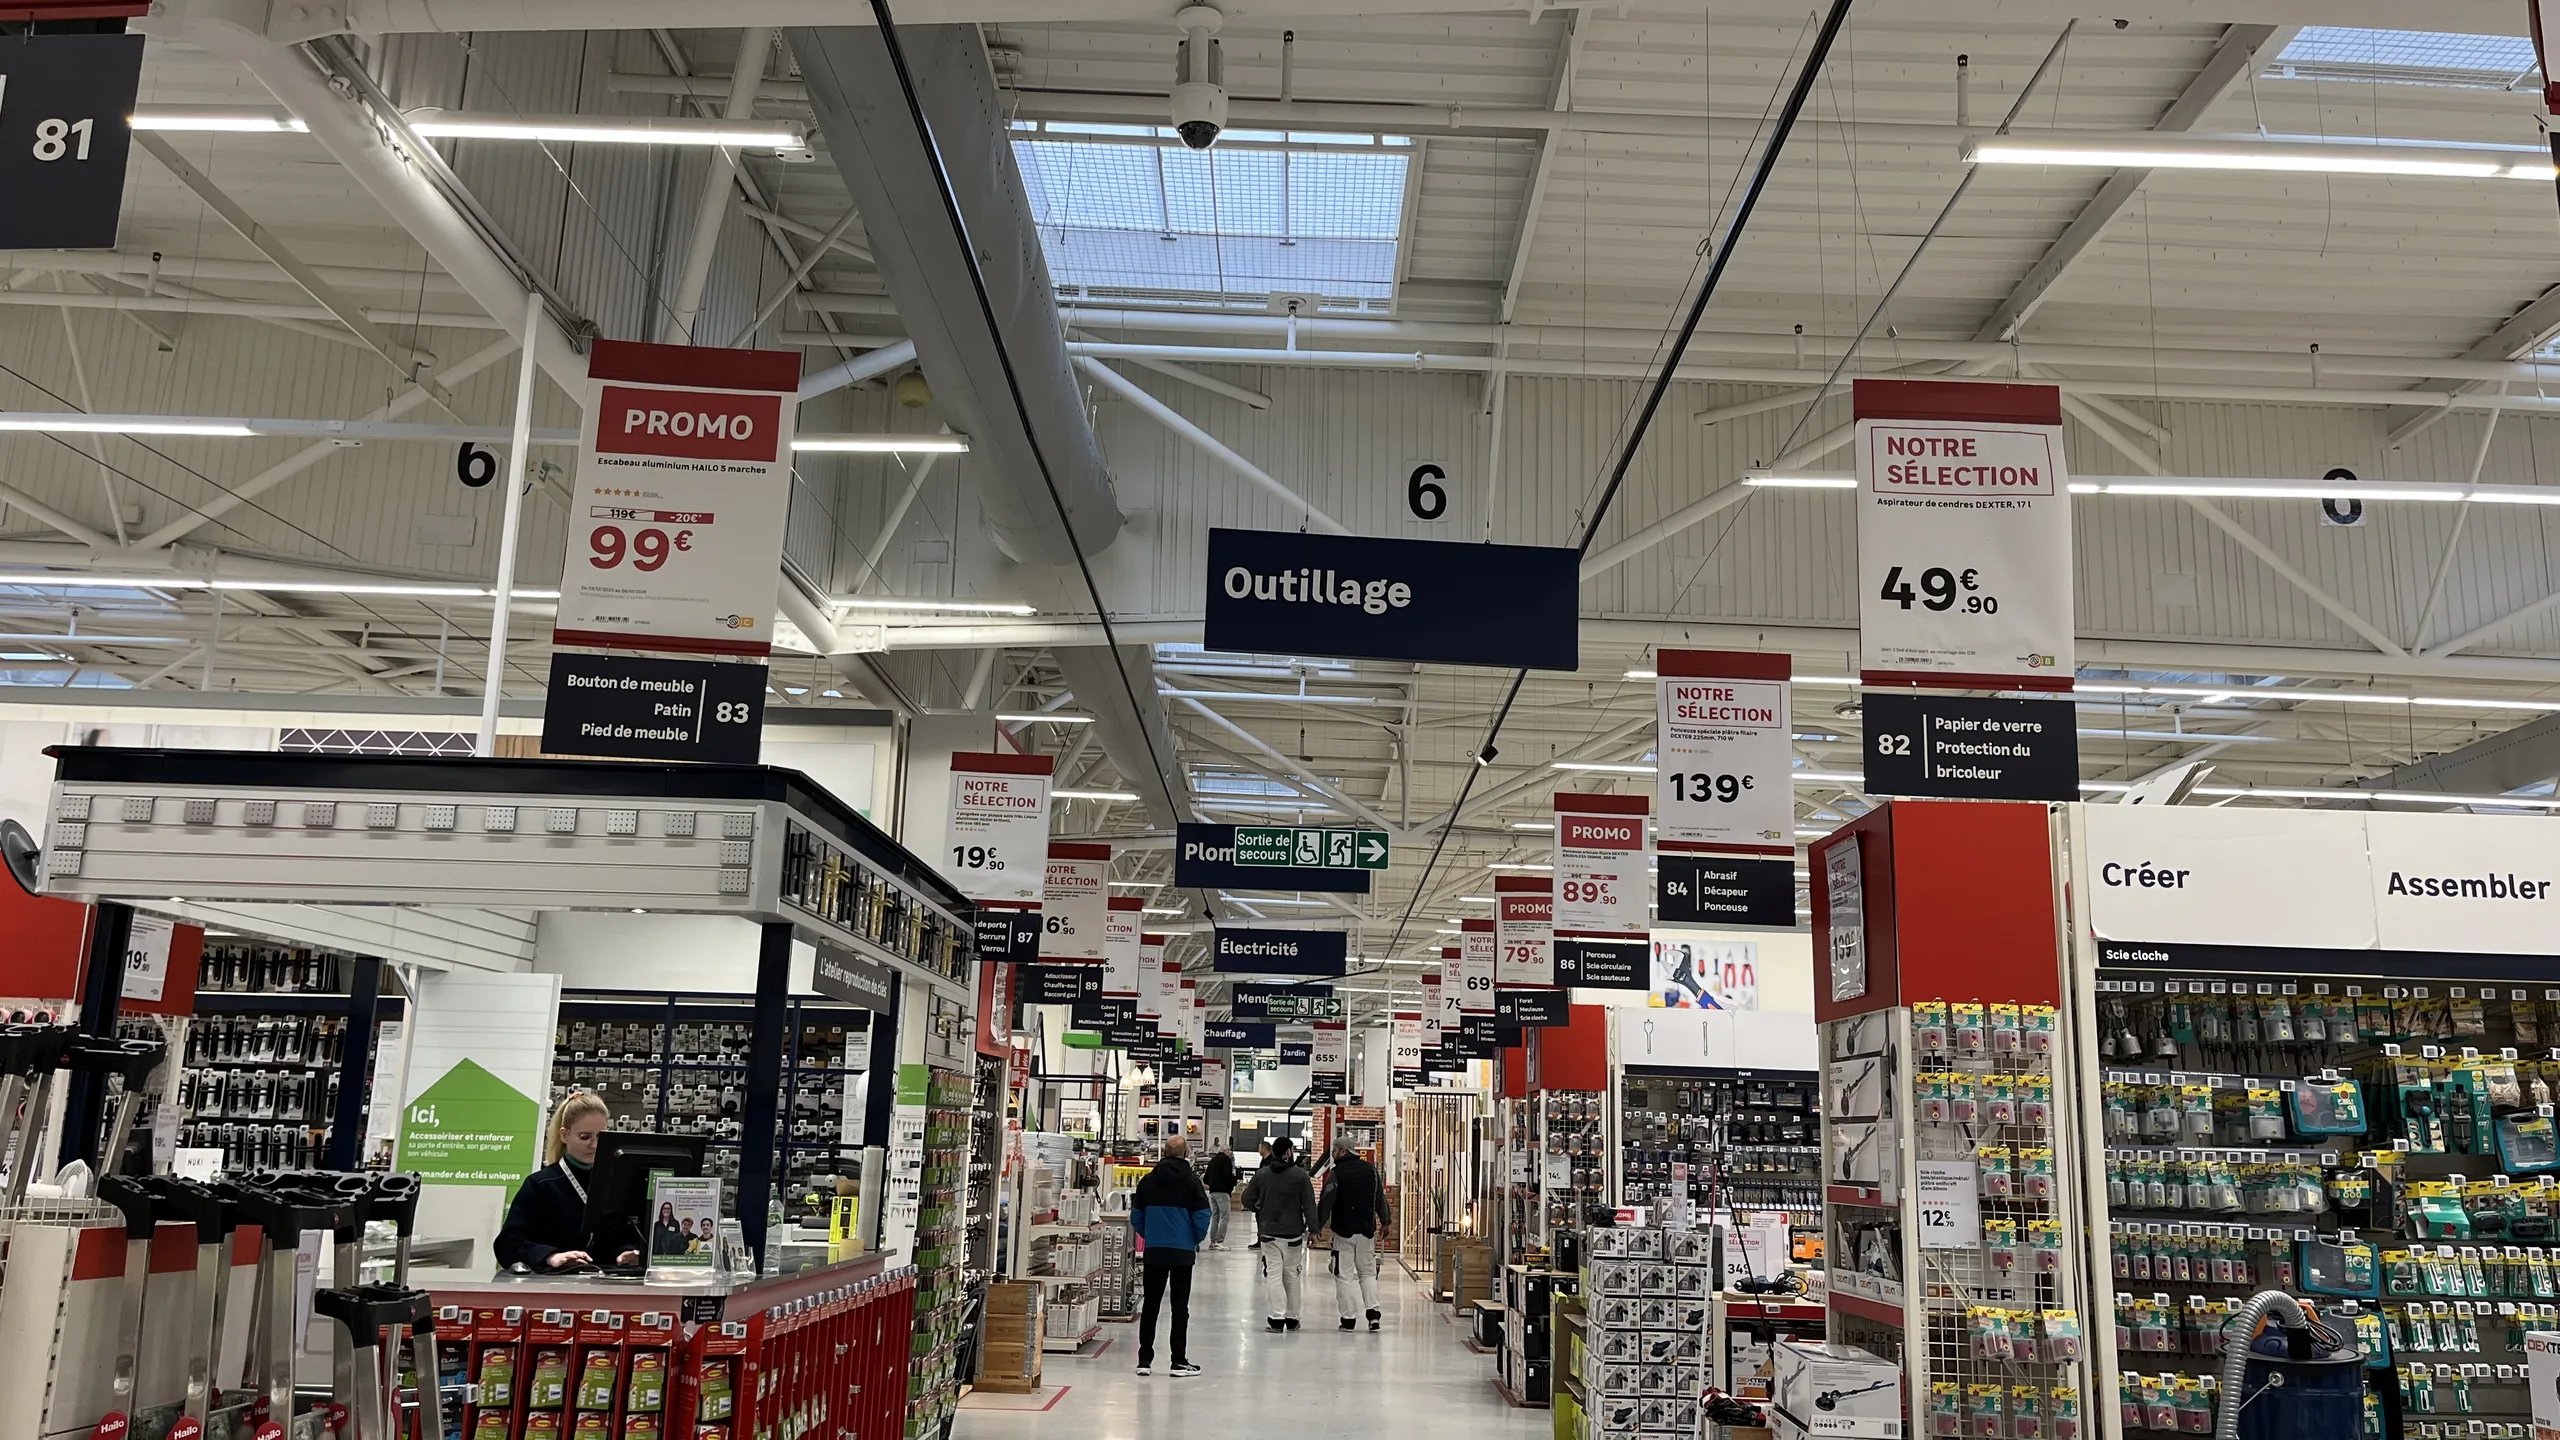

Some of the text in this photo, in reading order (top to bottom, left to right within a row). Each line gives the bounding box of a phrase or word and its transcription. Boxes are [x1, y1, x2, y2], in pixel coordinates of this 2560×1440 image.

[32, 118, 94, 162] 81
[624, 409, 754, 441] PROMO
[1887, 436, 1977, 457] NOTRE
[457, 441, 497, 488] 6
[598, 457, 767, 474] Escabeau aluminium HAILO 5 marches
[1887, 459, 2039, 487] SÉLECTION
[1407, 463, 1448, 520] 6
[1877, 498, 1924, 508] Aspirateur
[1925, 499, 1936, 508] de
[1938, 500, 1974, 509] cendres
[1976, 500, 2015, 510] DEXTER,
[2017, 500, 2026, 509] 17
[610, 508, 636, 519] 119€
[589, 525, 694, 572] 99€
[1224, 566, 1412, 615] Outillage
[567, 674, 694, 694] Bouton de meuble
[1677, 687, 1734, 701] NOTRE
[654, 703, 691, 717] Patin
[716, 701, 749, 724] 83
[1677, 701, 1772, 722] SÉLECTION
[581, 723, 689, 741] Pied de meuble
[1935, 717, 2042, 733] Papier de verre
[1878, 733, 1911, 756] 82
[1936, 741, 2031, 757] Protection du
[1936, 764, 2002, 780] bricoleur
[964, 780, 1009, 793] NOTRE
[1669, 772, 1754, 803] 139€
[963, 792, 1036, 808] SÉLECTION
[1237, 833, 1290, 847] Sortie de
[1572, 825, 1631, 841] PROMO
[1239, 850, 1287, 860] secours
[1703, 870, 1738, 881] Abrasif
[2101, 860, 2190, 889] Créer
[1667, 881, 1688, 896] 84
[1704, 886, 1748, 898] Décapeur
[2387, 870, 2551, 900] Assembler
[1704, 902, 1748, 912] Ponceuse
[987, 921, 1007, 930] porte
[978, 933, 1006, 941] Serrure
[1017, 932, 1033, 944] 87
[981, 945, 1005, 953] Verrou
[1220, 937, 1298, 956] Électricité
[1586, 951, 1616, 959] Perceuse
[2106, 949, 2169, 962] Scie cloche
[1560, 959, 1575, 970] 86
[1586, 962, 1632, 971] Scie circulaire
[820, 957, 844, 982] L'atelier
[843, 969, 872, 994] reproduction
[871, 977, 878, 994] de
[1044, 972, 1077, 980] Adoucisseur
[1600, 974, 1630, 982] sauteuse
[1085, 981, 1098, 991] 89
[1122, 1011, 1132, 1019] 91
[1499, 1005, 1512, 1014] 88
[1145, 1030, 1154, 1038] 93
[1204, 1029, 1247, 1040] Chauffage
[1464, 1027, 1475, 1035] 90
[1283, 1049, 1306, 1057] Jardin
[1315, 1054, 1338, 1062] 655€
[411, 1104, 440, 1128] Ici,
[409, 1132, 514, 1142] Accessoiriser et renforcer
[187, 1158, 204, 1166] NUKI
[455, 1171, 470, 1179] des
[471, 1171, 488, 1180] clés
[489, 1172, 521, 1181] uniques
[100, 1419, 124, 1433] Hailo
[174, 1425, 198, 1439] Hailo
[257, 1428, 281, 1440] Hailo
